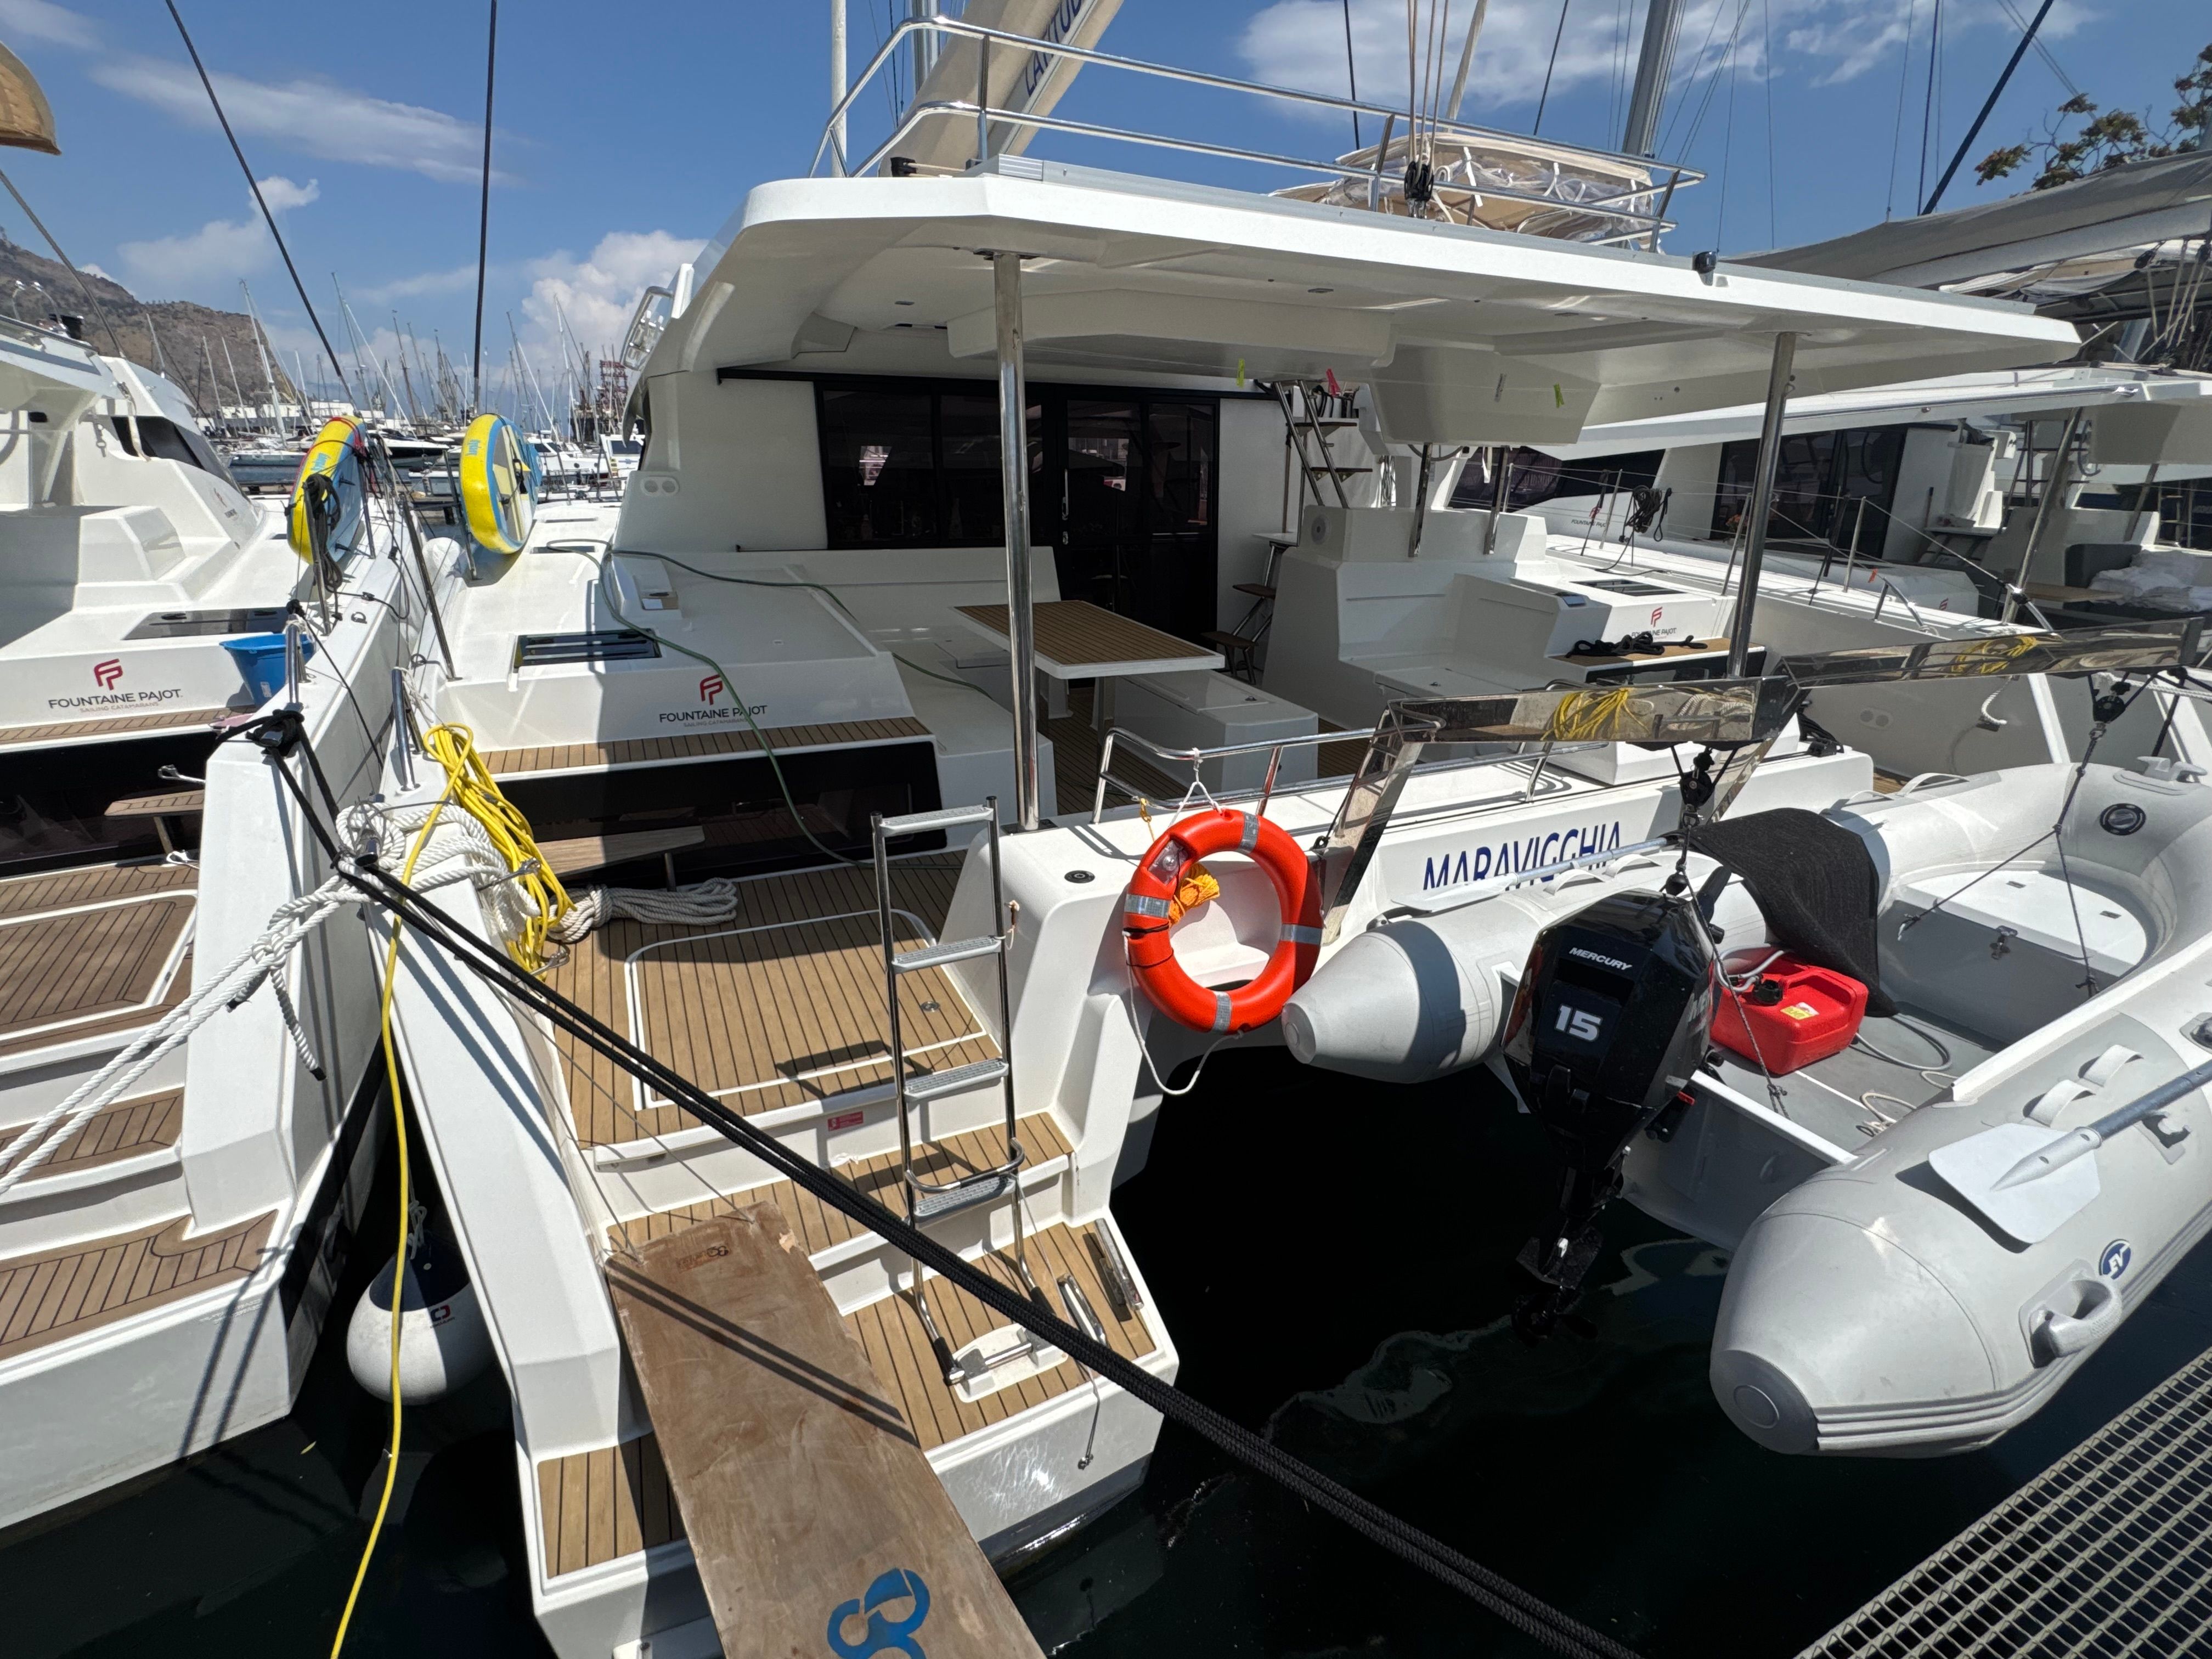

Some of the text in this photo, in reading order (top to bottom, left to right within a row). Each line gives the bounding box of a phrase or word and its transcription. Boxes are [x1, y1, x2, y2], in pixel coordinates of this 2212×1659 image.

[48, 689, 182, 709] FOUNTAINE PAJOT
[111, 702, 159, 710] CATAMARANS
[659, 705, 768, 723] FOUNTAINE PJOT
[1569, 947, 1633, 971] MERCURY
[1554, 1003, 1603, 1042] 15
